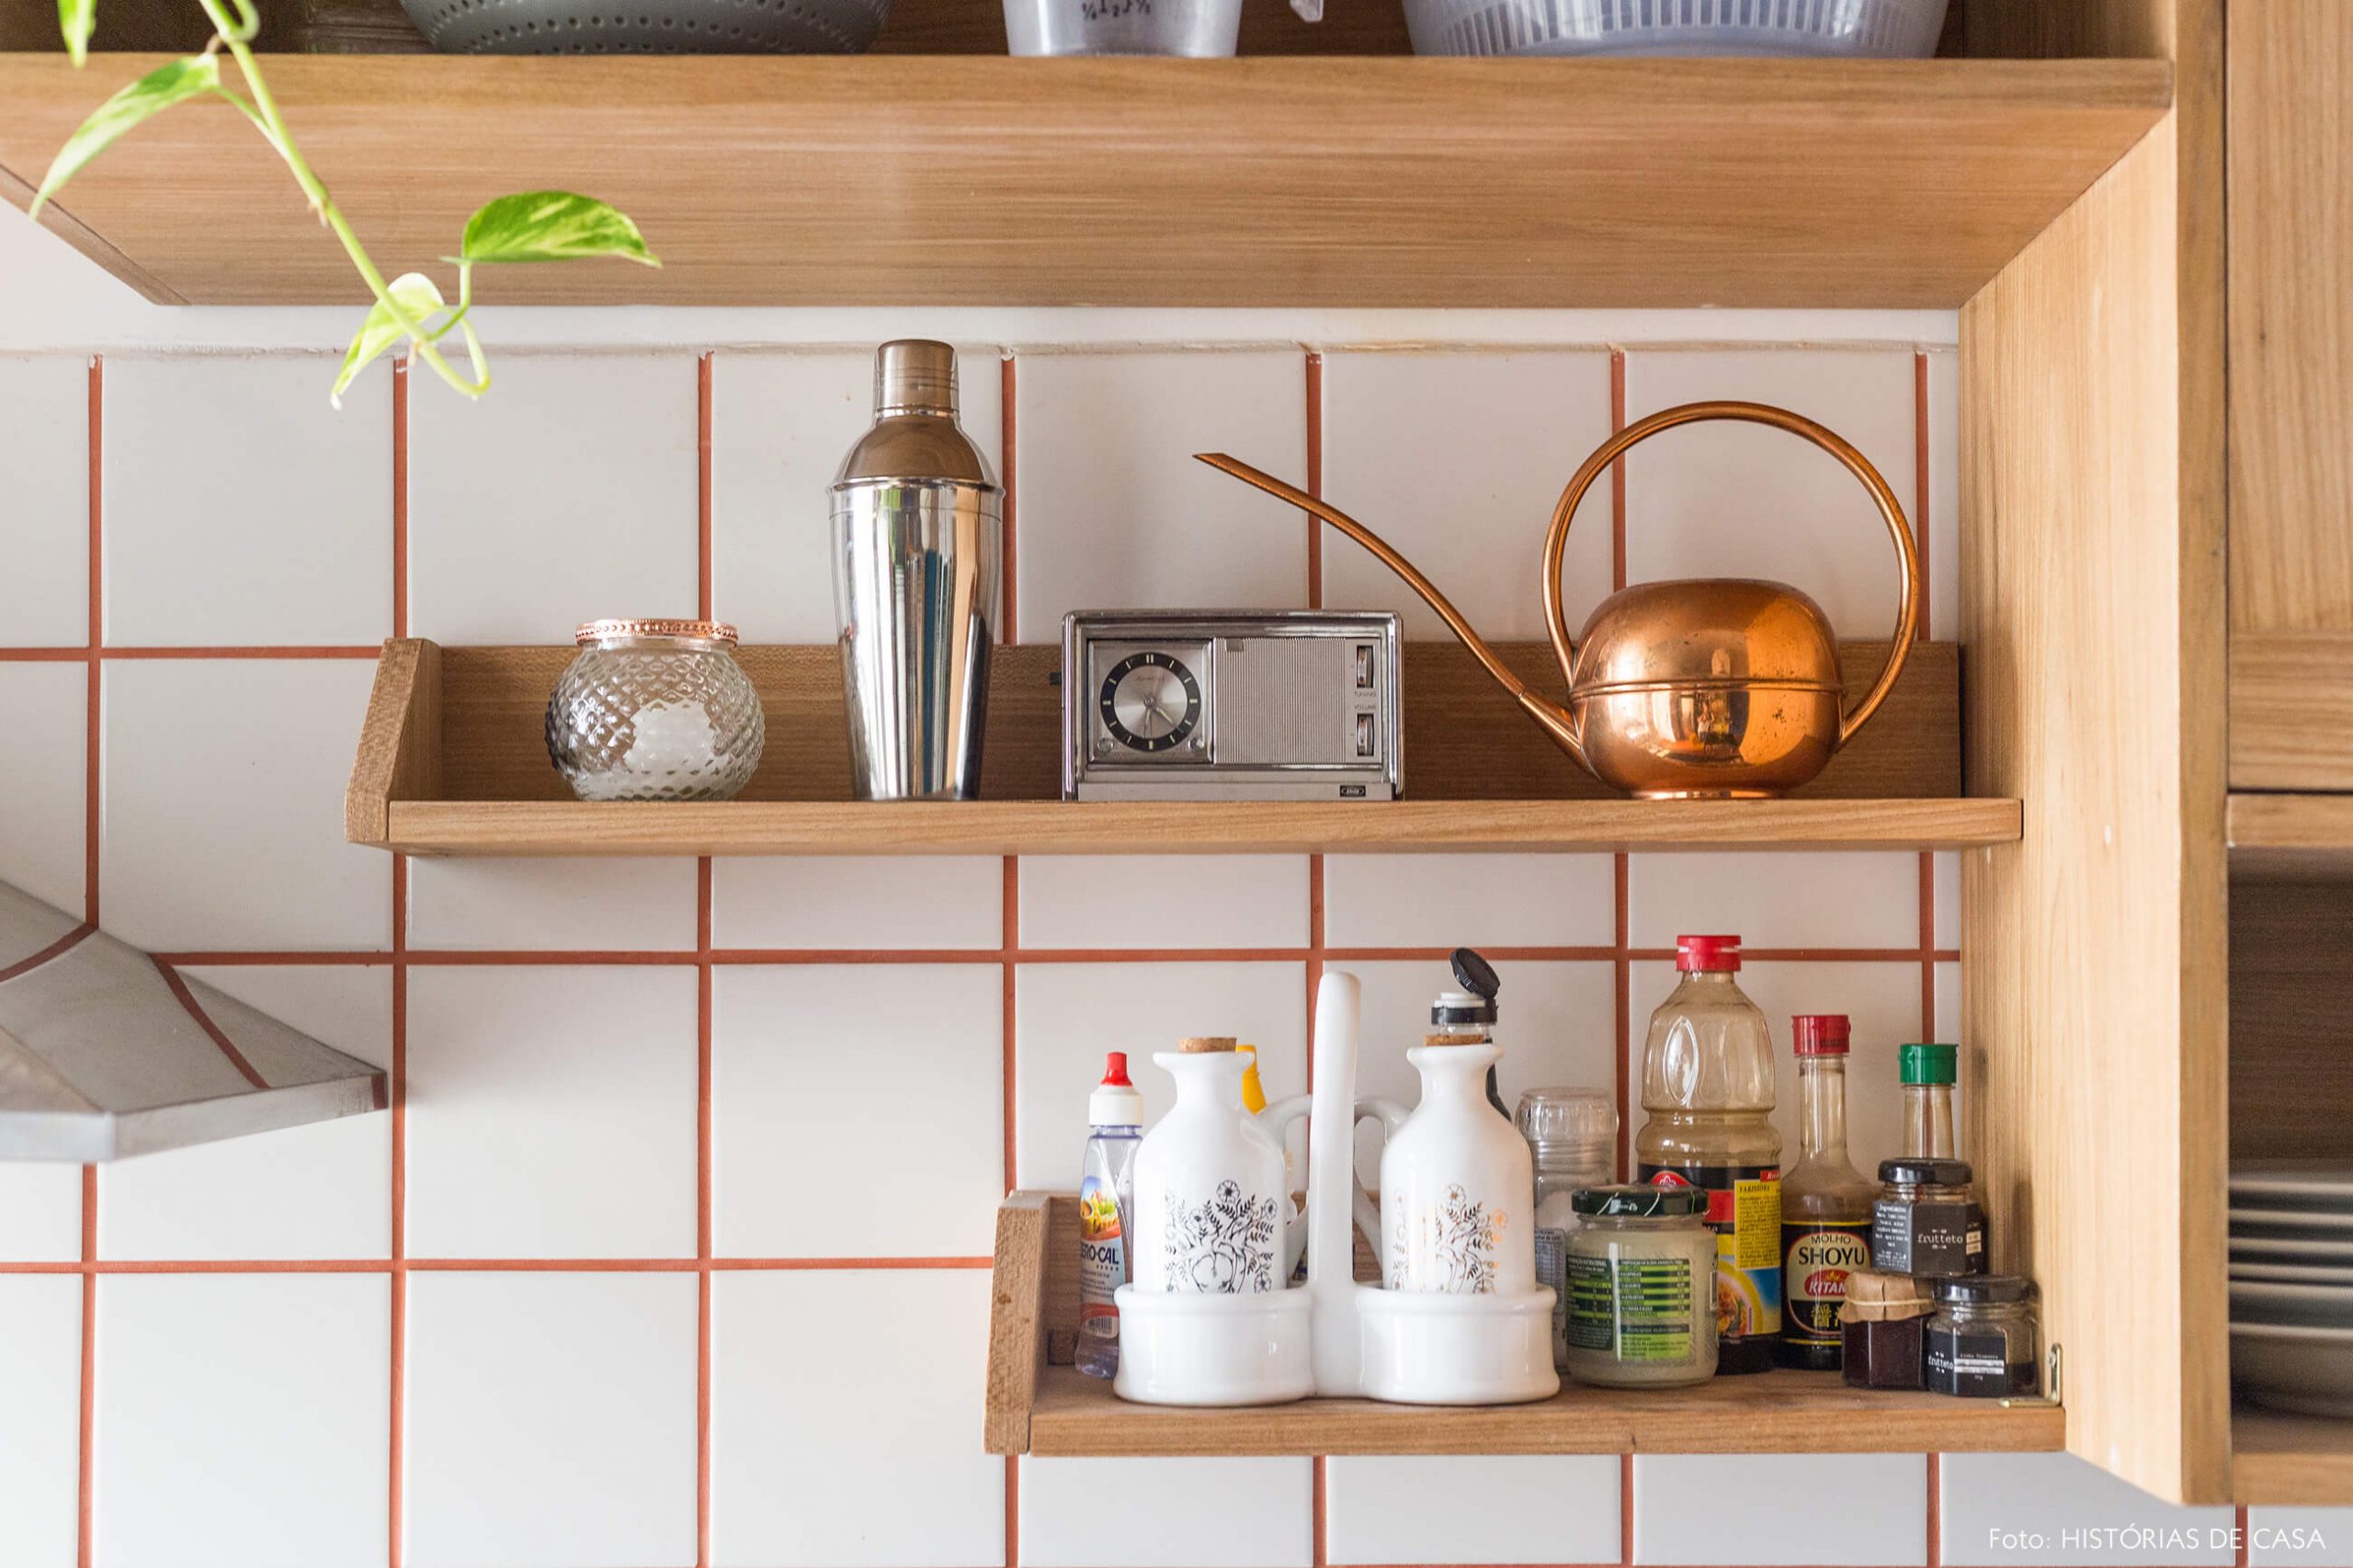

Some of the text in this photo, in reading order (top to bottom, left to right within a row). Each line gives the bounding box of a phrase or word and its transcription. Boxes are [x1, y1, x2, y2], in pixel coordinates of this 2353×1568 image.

[1811, 1233, 1852, 1244] MOLHO
[1917, 1233, 1964, 1244] frutteto
[1081, 1242, 1120, 1266] ERO-CAL
[1798, 1246, 1865, 1267] SHOYU
[1809, 1279, 1847, 1294] KITAN
